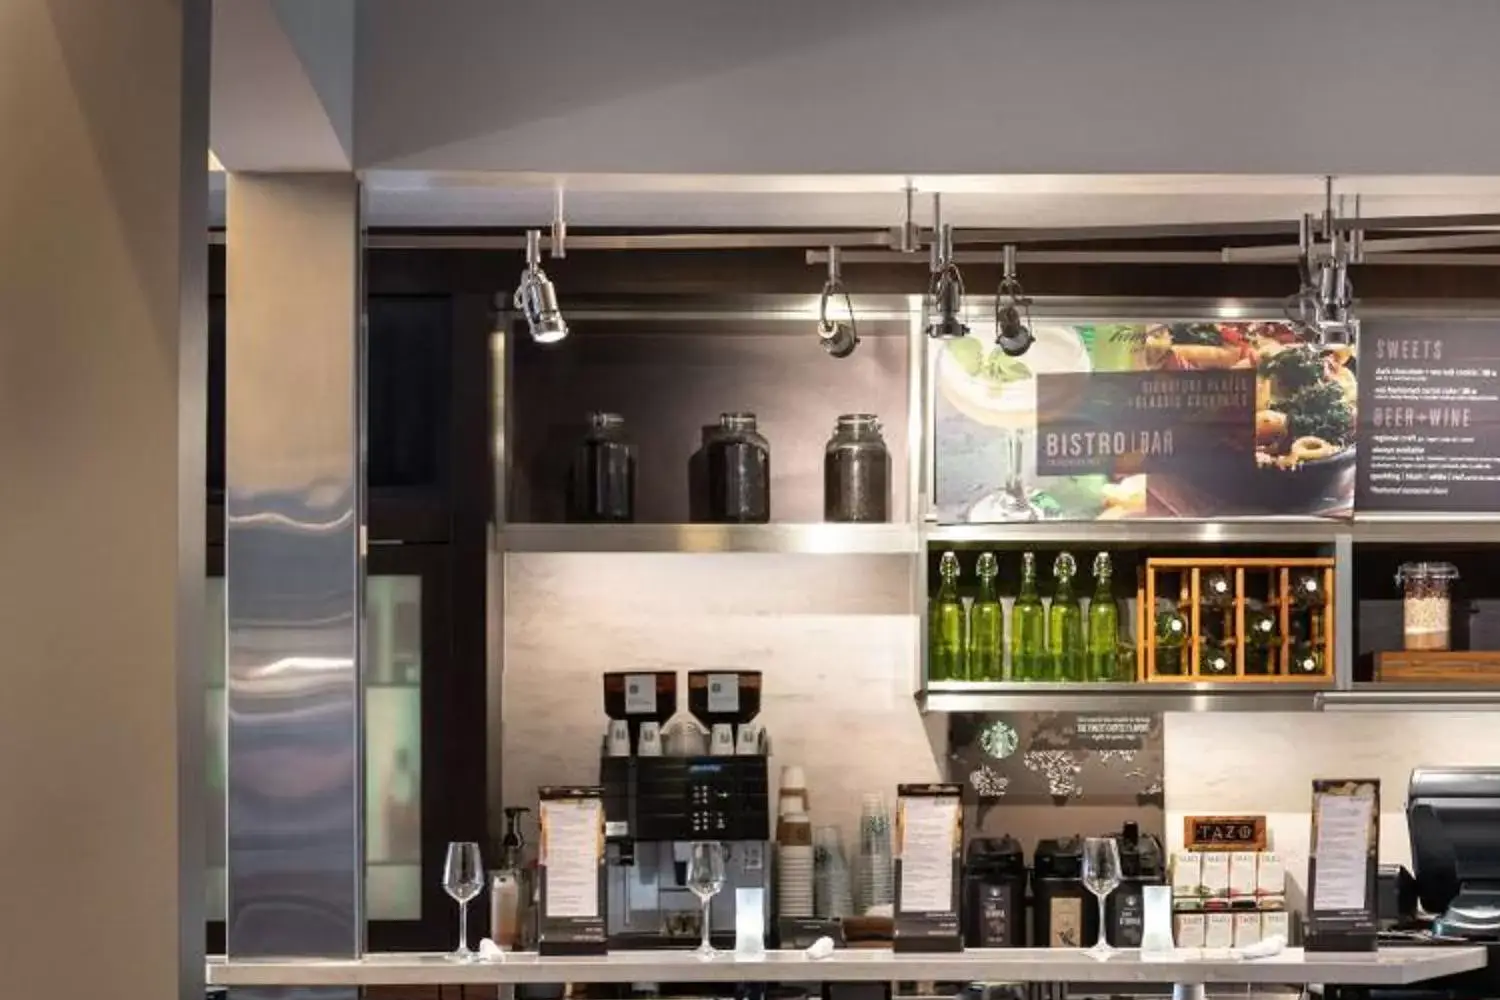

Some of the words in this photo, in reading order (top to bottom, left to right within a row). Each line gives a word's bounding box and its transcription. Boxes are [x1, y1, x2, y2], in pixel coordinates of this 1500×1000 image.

[1376, 339, 1444, 361] SWEETS
[1045, 431, 1126, 457] BISTRO
[1140, 429, 1174, 454] BAR
[1202, 825, 1252, 840] TAZO
